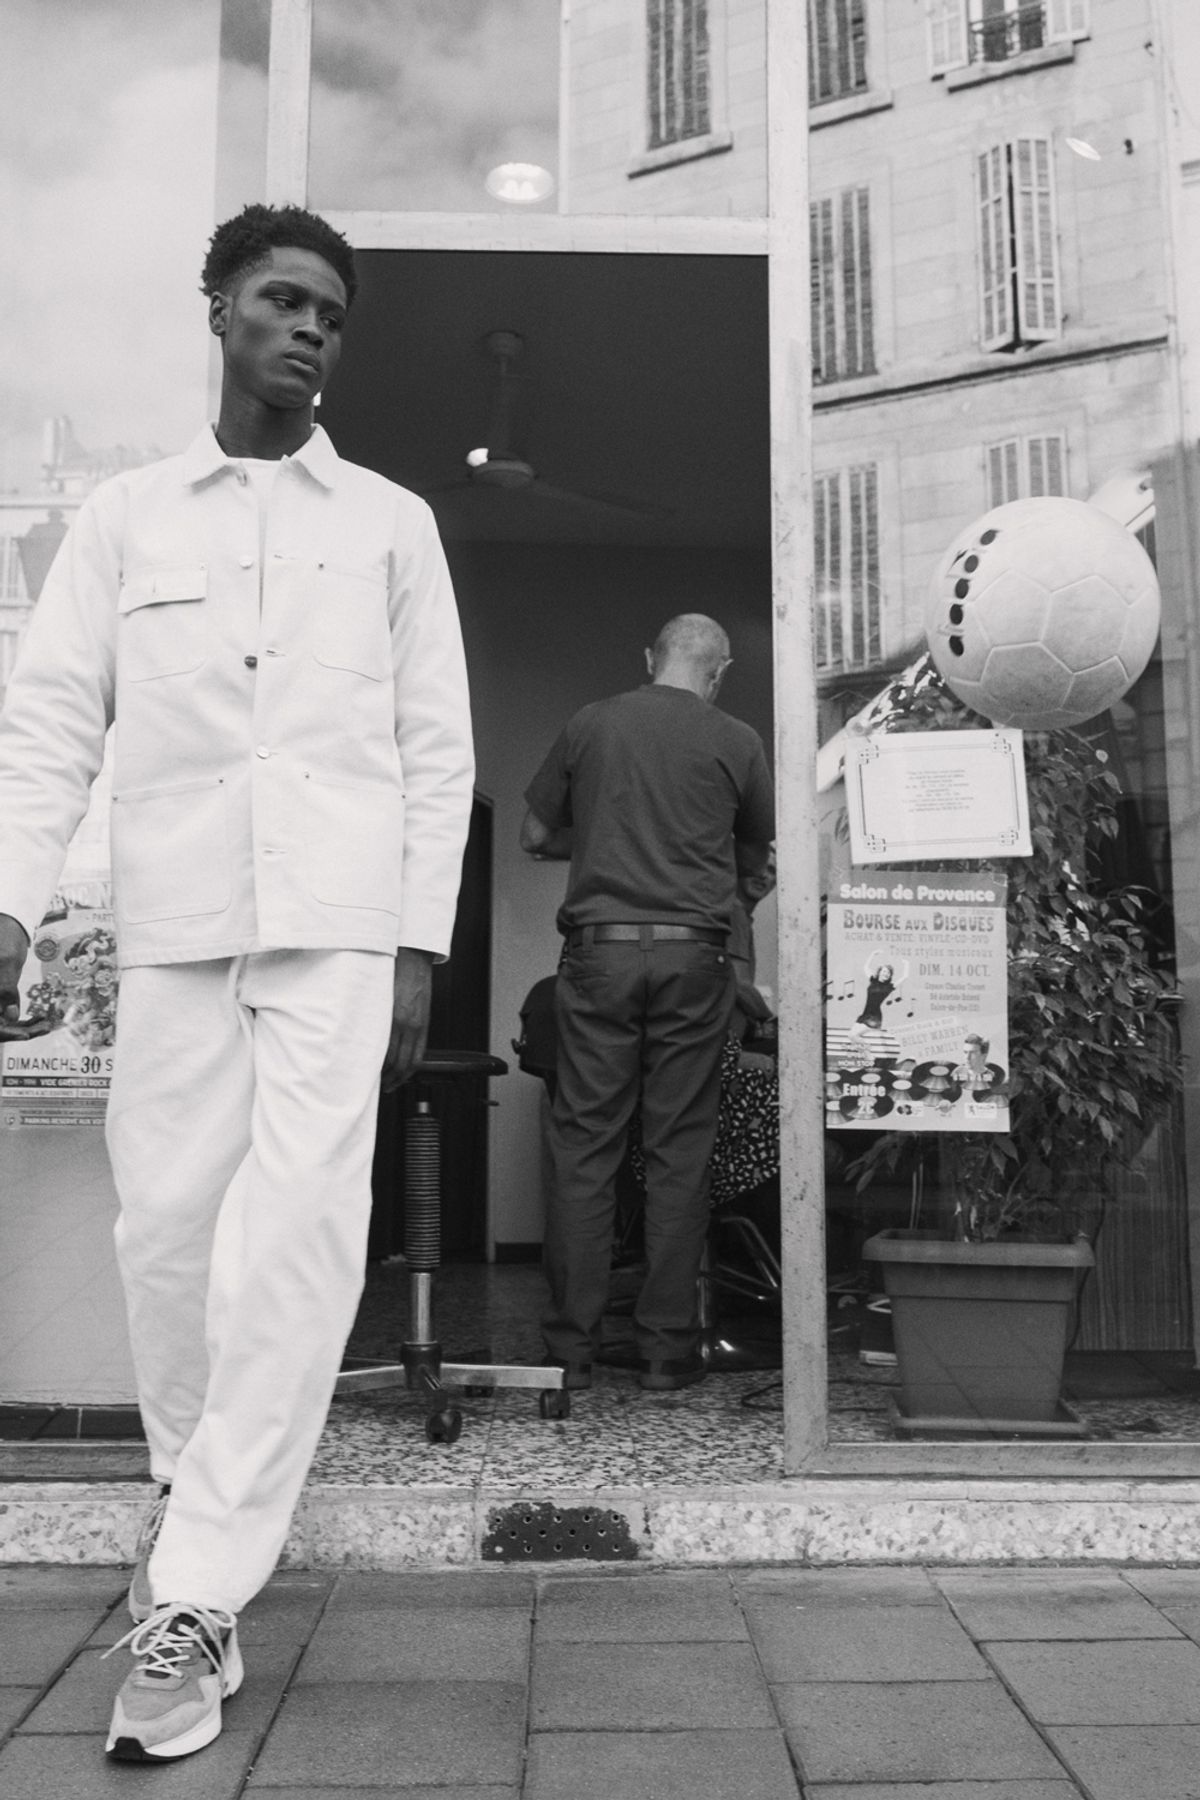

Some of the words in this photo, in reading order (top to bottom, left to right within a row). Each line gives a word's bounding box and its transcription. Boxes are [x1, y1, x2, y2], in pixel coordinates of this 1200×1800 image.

[840, 883, 888, 899] Salon
[891, 884, 913, 900] de
[917, 885, 995, 901] Provence
[844, 909, 900, 930] BOURSE
[904, 918, 929, 931] AUX
[932, 911, 995, 932] DISQUES
[844, 932, 875, 942] ACHAT
[919, 963, 945, 977] DIM.
[949, 963, 962, 977] 14
[966, 964, 992, 977] OCT.
[7, 1056, 79, 1071] DIMANCHE
[80, 1055, 102, 1074] 30
[843, 1082, 886, 1097] Entrée
